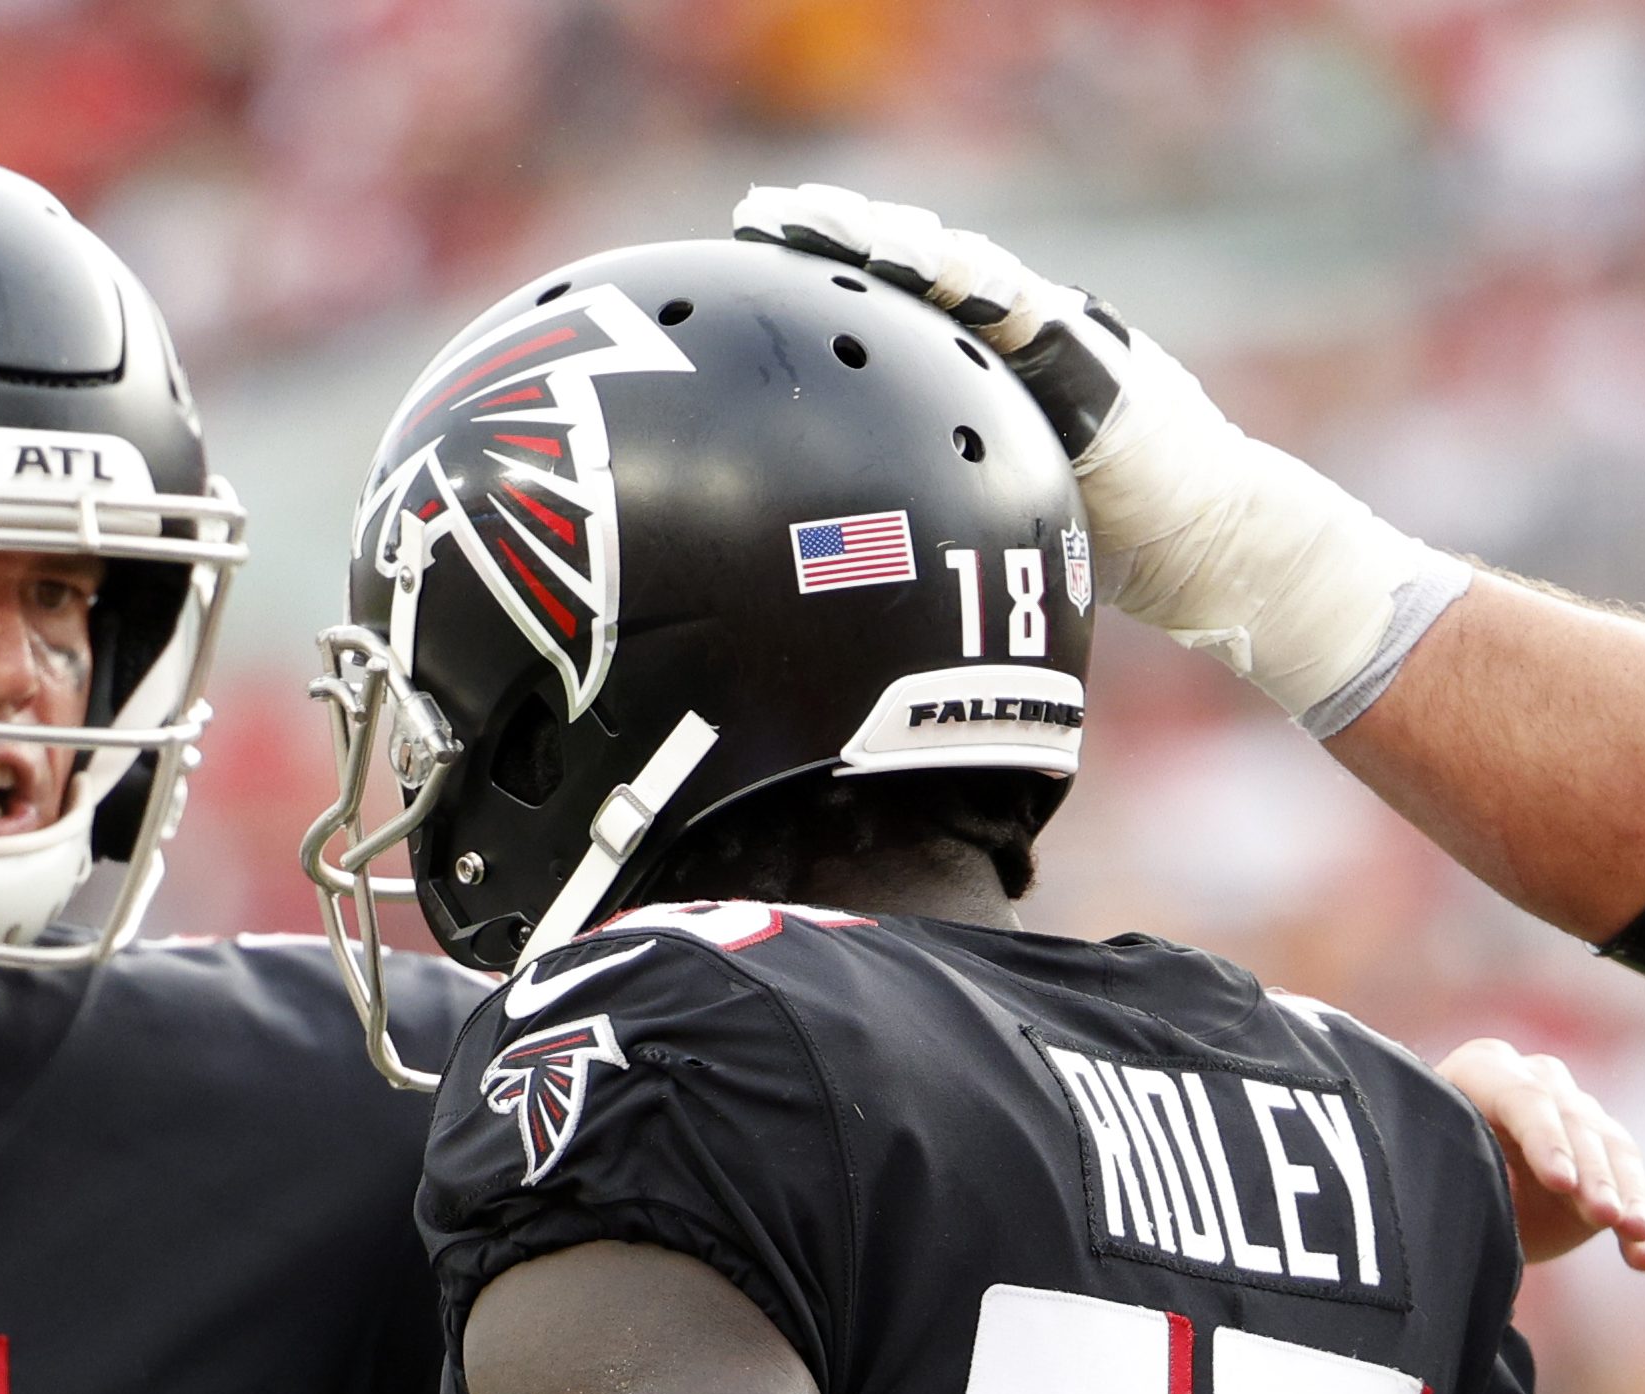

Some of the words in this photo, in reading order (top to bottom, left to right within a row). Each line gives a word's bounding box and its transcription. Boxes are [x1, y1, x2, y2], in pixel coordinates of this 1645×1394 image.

[13, 445, 113, 482] ATL
[1068, 562, 1089, 597] NFL
[945, 548, 1051, 658] 18
[909, 697, 1085, 729] FALCONS
[1045, 1045, 1381, 1287] RIDLEY
